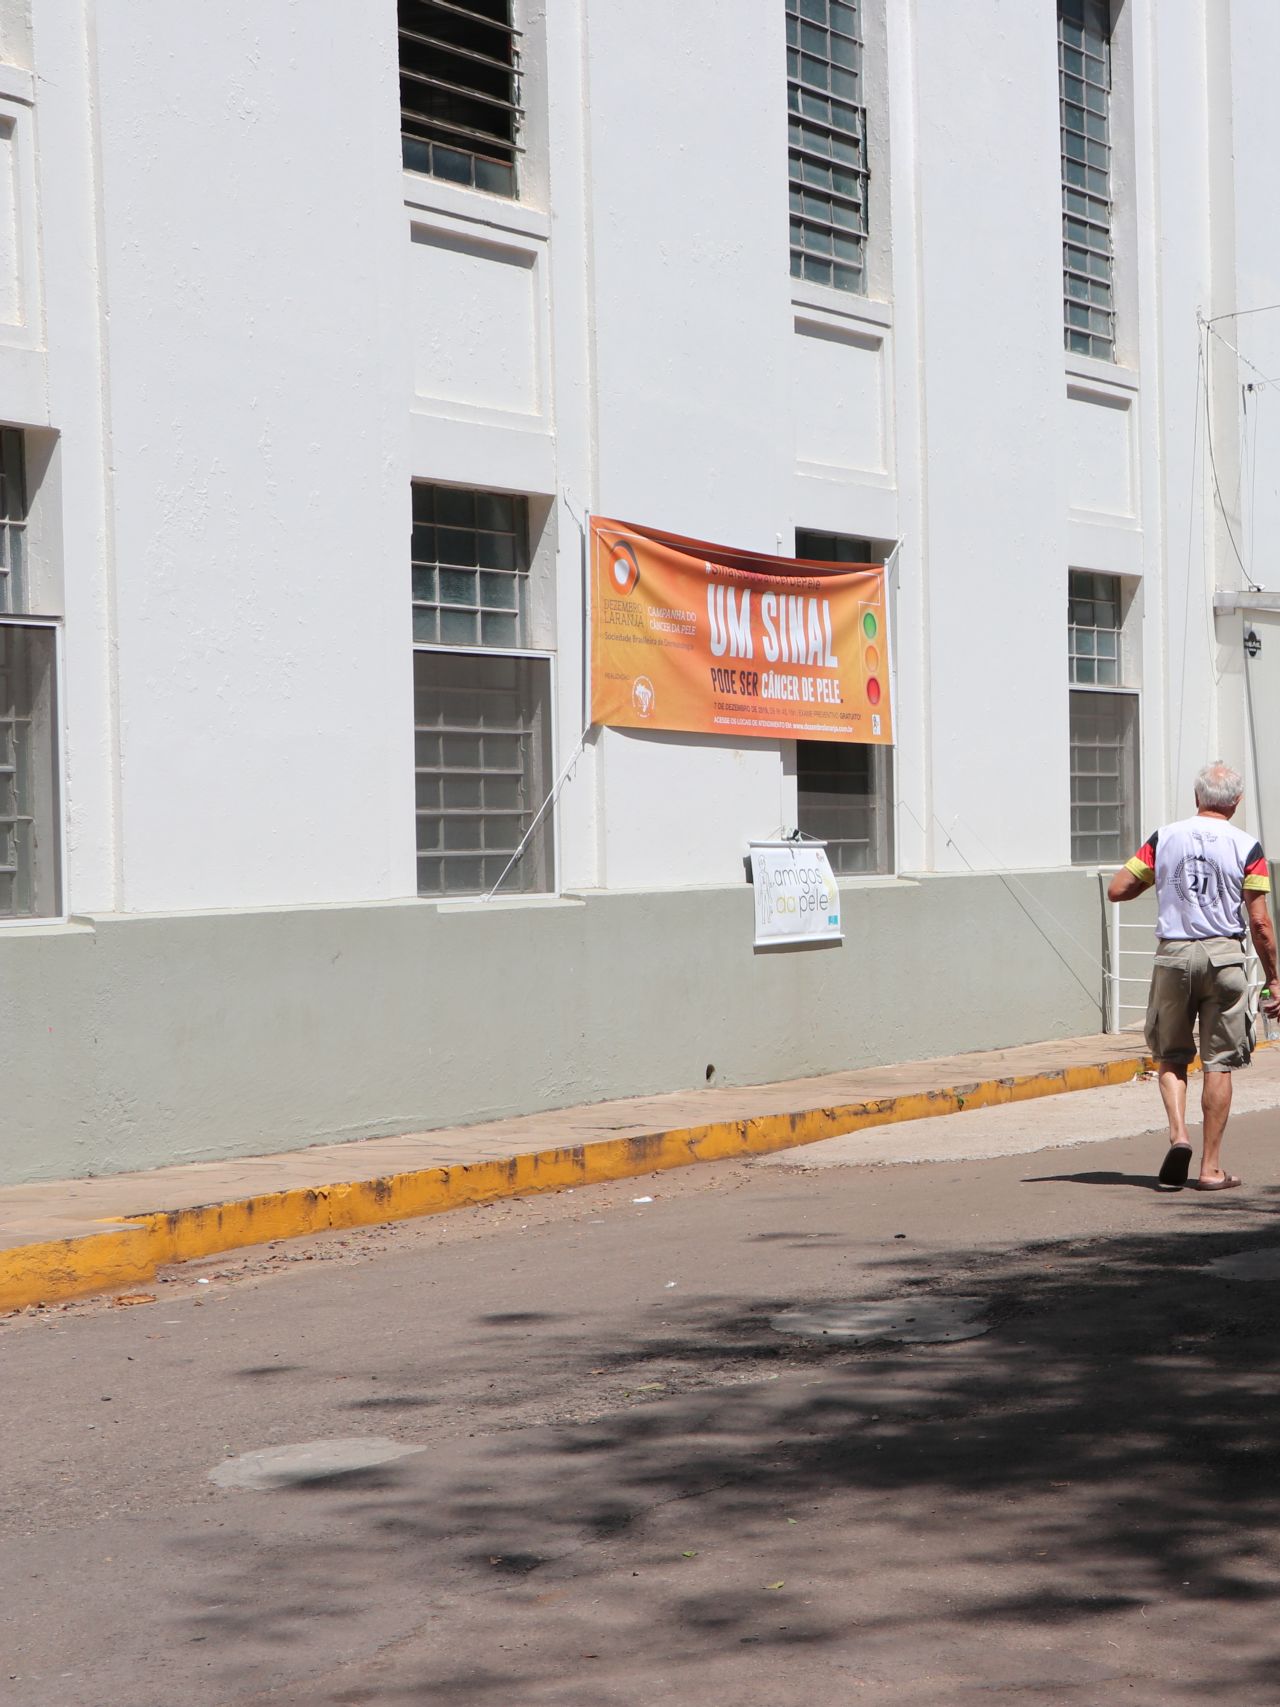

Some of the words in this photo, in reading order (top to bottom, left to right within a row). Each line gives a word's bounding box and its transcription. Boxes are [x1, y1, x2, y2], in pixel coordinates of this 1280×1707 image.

[603, 598, 642, 614] DEZEMBRO
[647, 606, 686, 620] CAMPANHA
[686, 611, 697, 622] DO
[603, 611, 644, 628] LARANJA
[681, 624, 696, 636] PELE
[707, 583, 753, 659] UM
[761, 591, 838, 668] SINAL
[710, 668, 737, 694] PODE
[739, 670, 759, 697] SER
[761, 670, 800, 701] CÂNCER
[801, 677, 815, 702] DE
[774, 866, 823, 895] amigos
[1188, 873, 1208, 895] 21
[776, 895, 796, 914] da
[799, 888, 829, 919] pele
